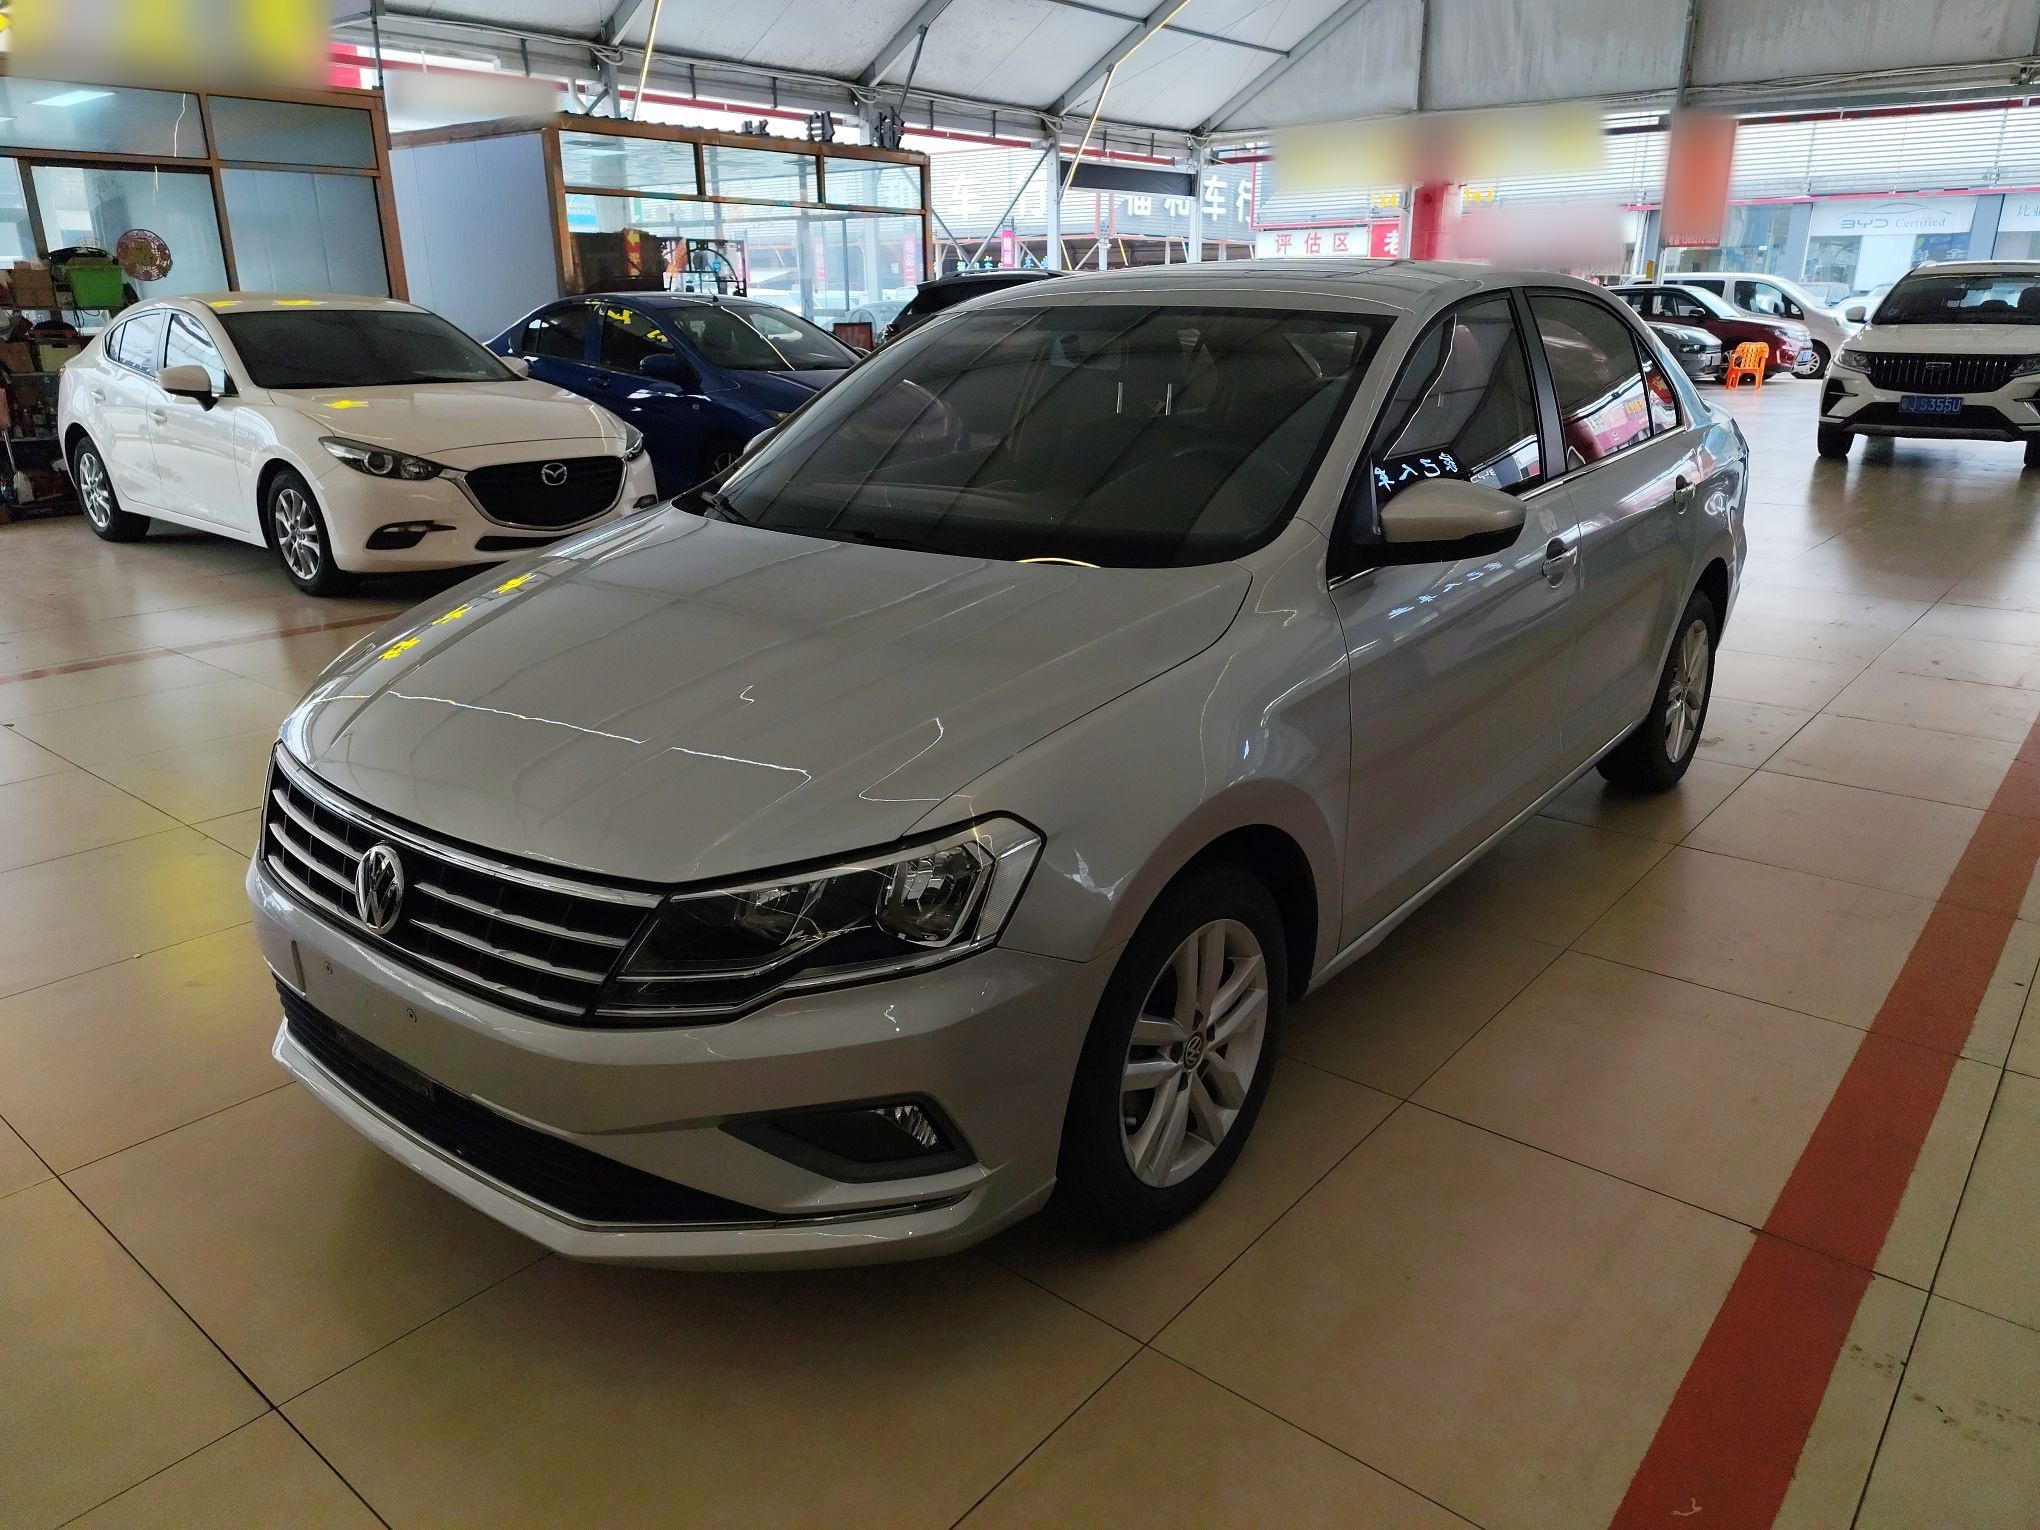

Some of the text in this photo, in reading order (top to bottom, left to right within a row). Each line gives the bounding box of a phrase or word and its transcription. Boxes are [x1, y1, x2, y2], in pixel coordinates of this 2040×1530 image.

[1840, 217, 1946, 229] BYD Certified
[1275, 232, 1350, 254] 评估区
